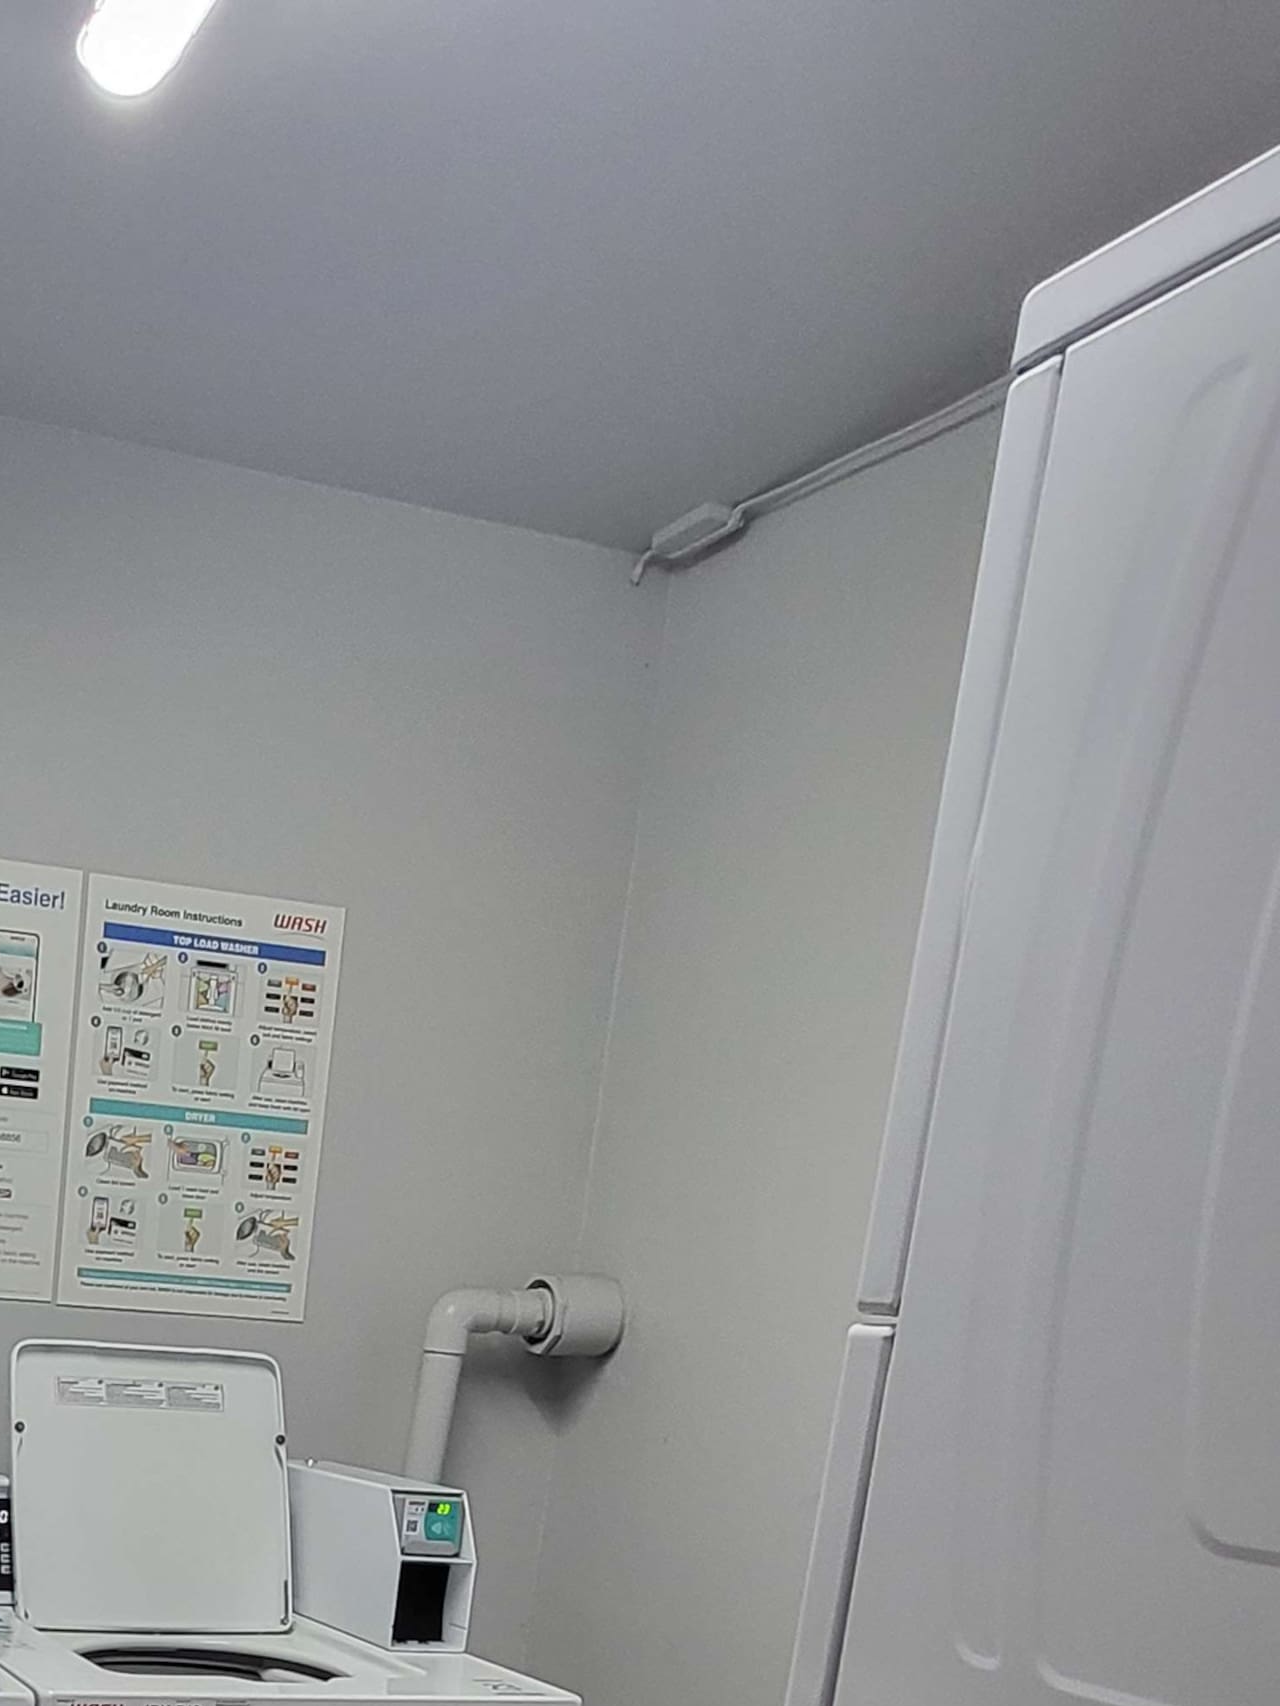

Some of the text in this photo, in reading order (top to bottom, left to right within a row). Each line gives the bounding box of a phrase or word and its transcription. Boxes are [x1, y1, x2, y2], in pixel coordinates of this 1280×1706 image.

[105, 898, 243, 928] Laundry Room Instructions
[273, 913, 328, 935] WASH
[173, 935, 259, 956] TOP LOAD WASHER
[184, 1111, 216, 1124] DRYER
